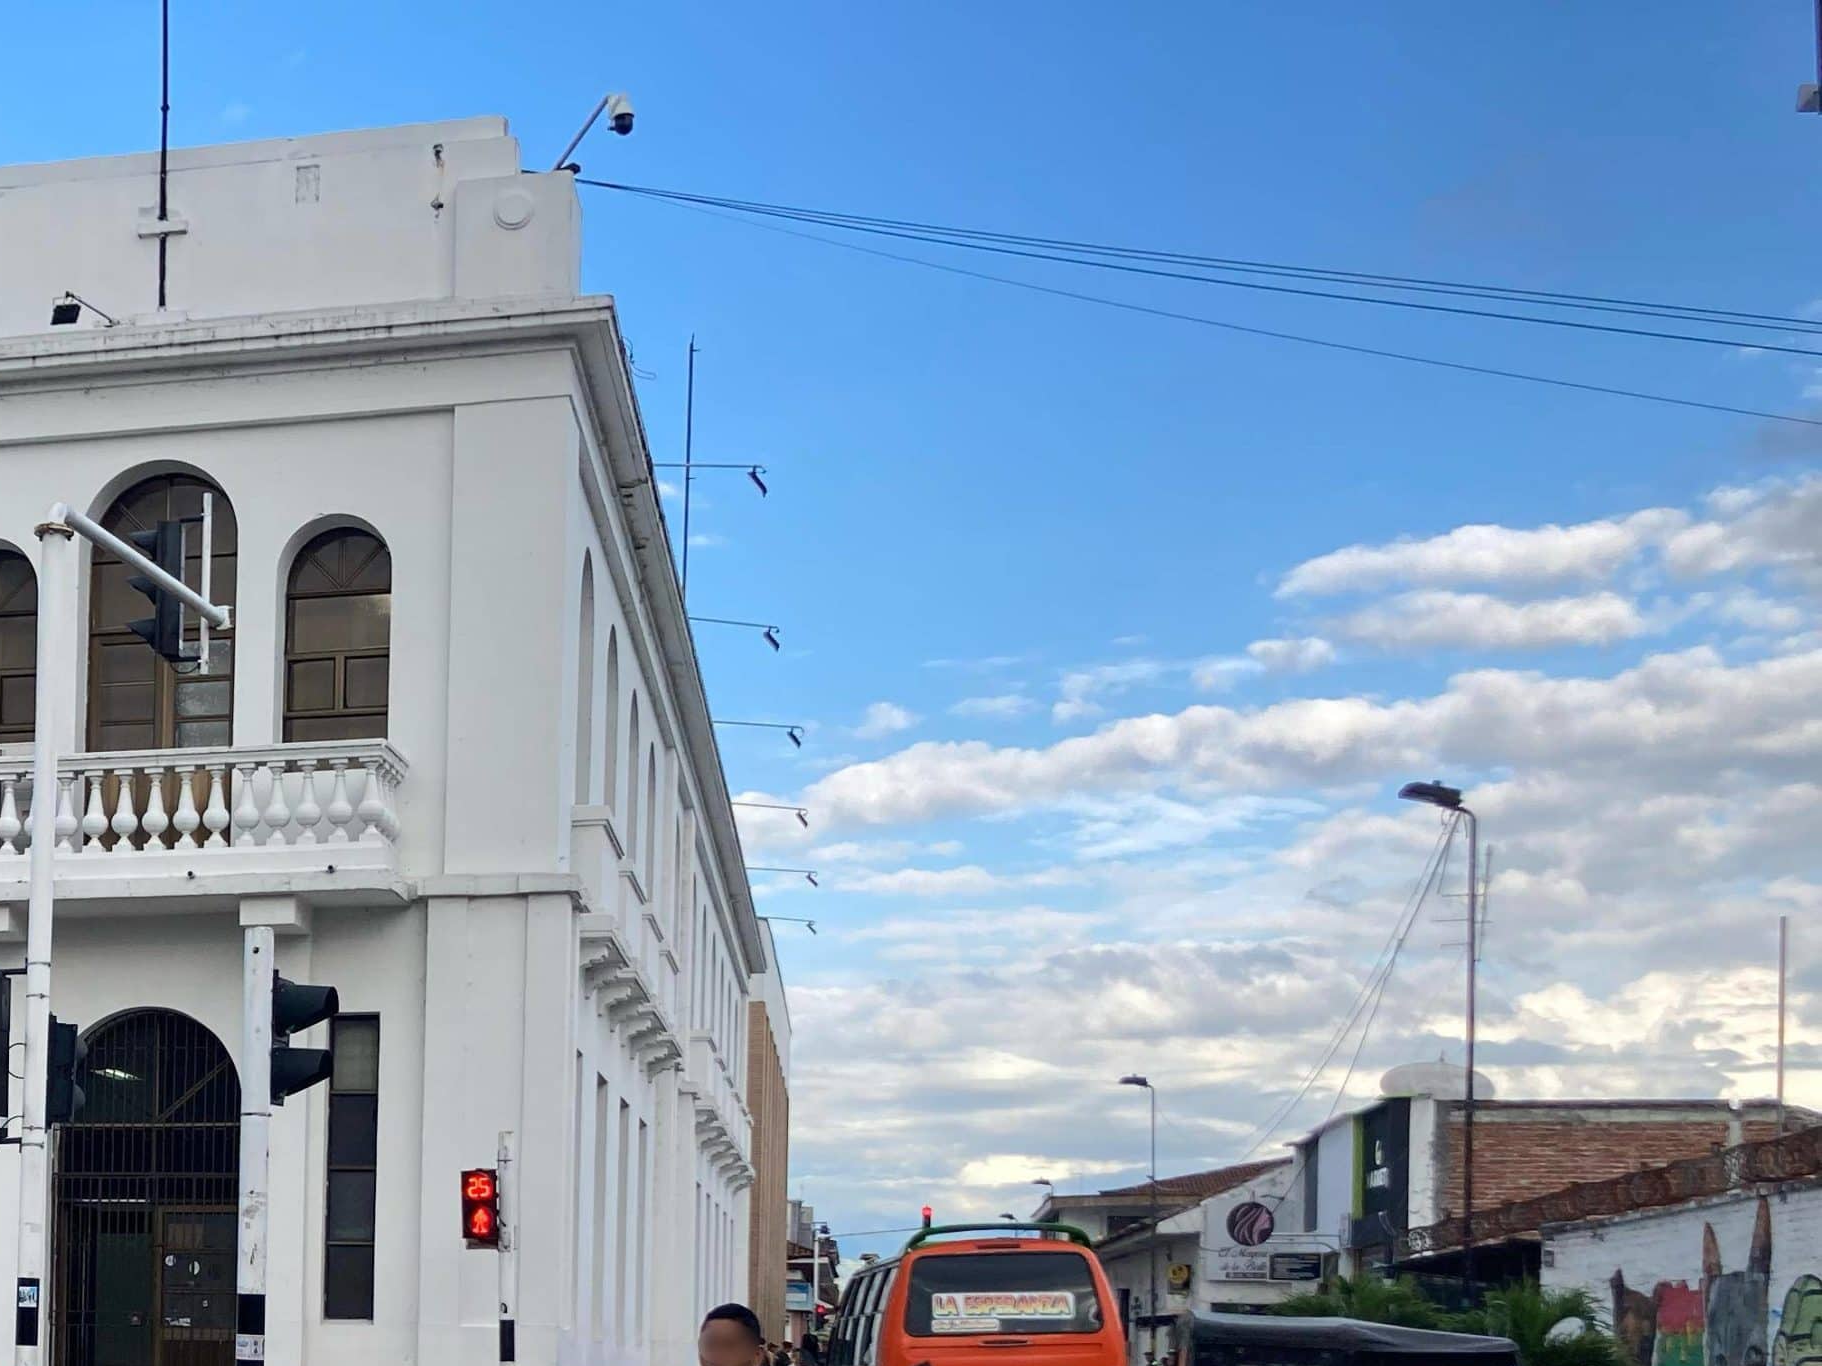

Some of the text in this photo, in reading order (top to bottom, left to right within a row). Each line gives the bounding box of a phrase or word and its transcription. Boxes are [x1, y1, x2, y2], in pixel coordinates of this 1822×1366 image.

[467, 1177, 491, 1198] 25
[934, 1294, 1071, 1316] LA ESPERANZA
